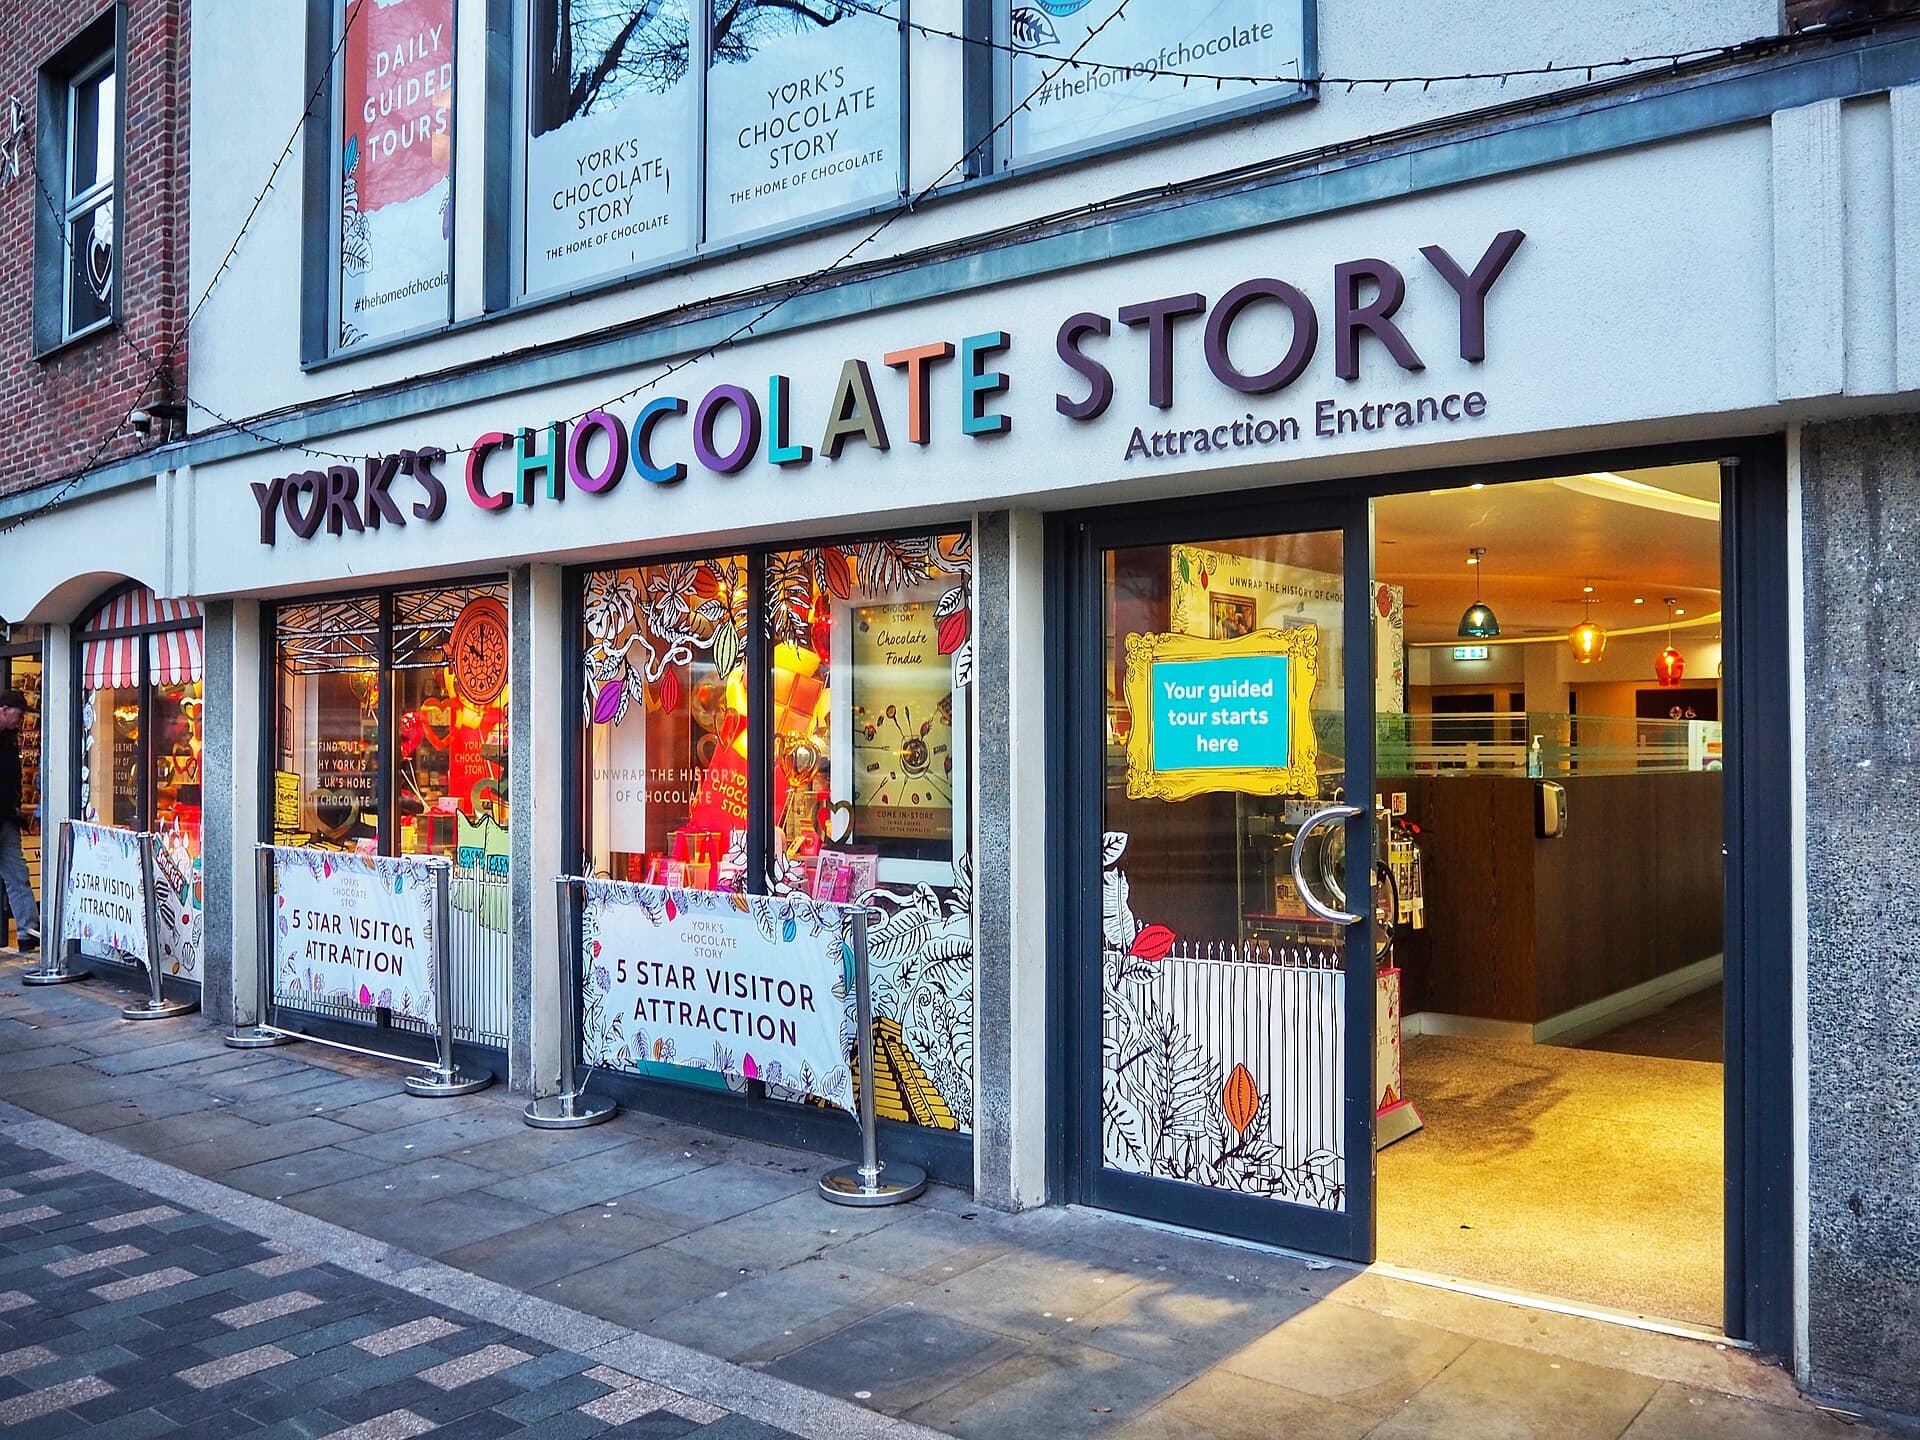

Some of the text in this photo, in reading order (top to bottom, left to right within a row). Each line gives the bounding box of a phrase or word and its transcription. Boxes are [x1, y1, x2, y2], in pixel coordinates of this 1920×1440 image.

[376, 23, 443, 79] DAILY
[1038, 23, 1274, 106] #thehomeofchocolate
[363, 63, 452, 123] GUIDED
[766, 66, 844, 110] YORK'S
[738, 86, 875, 149] CHOCOLATE
[368, 107, 447, 163] TOURS
[576, 138, 638, 176] YORK'S
[769, 128, 839, 169] STORY
[552, 157, 663, 211] CHOCOLATE
[730, 149, 884, 205] THE HOME OF CHOCOLATE
[578, 194, 634, 230] STORY
[546, 213, 670, 261] THE HOME OF CHOCOLATE
[250, 228, 1528, 546] YORK'S CHOCOLATE STORY
[1124, 391, 1487, 462] Attraction Entrance
[1229, 576, 1263, 591] UNWRAP
[1265, 581, 1280, 593] THE
[1281, 584, 1313, 599] HISTORY
[1314, 590, 1325, 599] OF
[892, 614, 914, 623] STORY
[876, 629, 928, 647] Chocolate
[886, 651, 923, 665] Fondue
[1164, 679, 1273, 703] Your guided
[1168, 708, 1269, 726] tour starts
[318, 741, 359, 753] FIND OUT
[1196, 734, 1239, 752] here
[332, 759, 355, 770] YORK
[357, 760, 367, 771] IS
[593, 768, 736, 783] UNWRAP THE HISTORY
[324, 777, 344, 788] UK'S
[346, 777, 372, 788] HOME
[320, 795, 371, 807] CHOCOLATE
[615, 790, 712, 804] OF CHOCOLATE
[75, 872, 80, 889] 5
[81, 872, 100, 892] STAR
[80, 897, 132, 925] ATTRACTION
[292, 909, 301, 929] 5
[307, 910, 342, 935] STAR
[692, 920, 725, 934] YORK'S
[680, 932, 737, 949] CHOCOLATE
[693, 946, 723, 960] STORY
[616, 958, 816, 1013] 5 STAR VISITOR
[633, 996, 797, 1048] ATTRACTION
